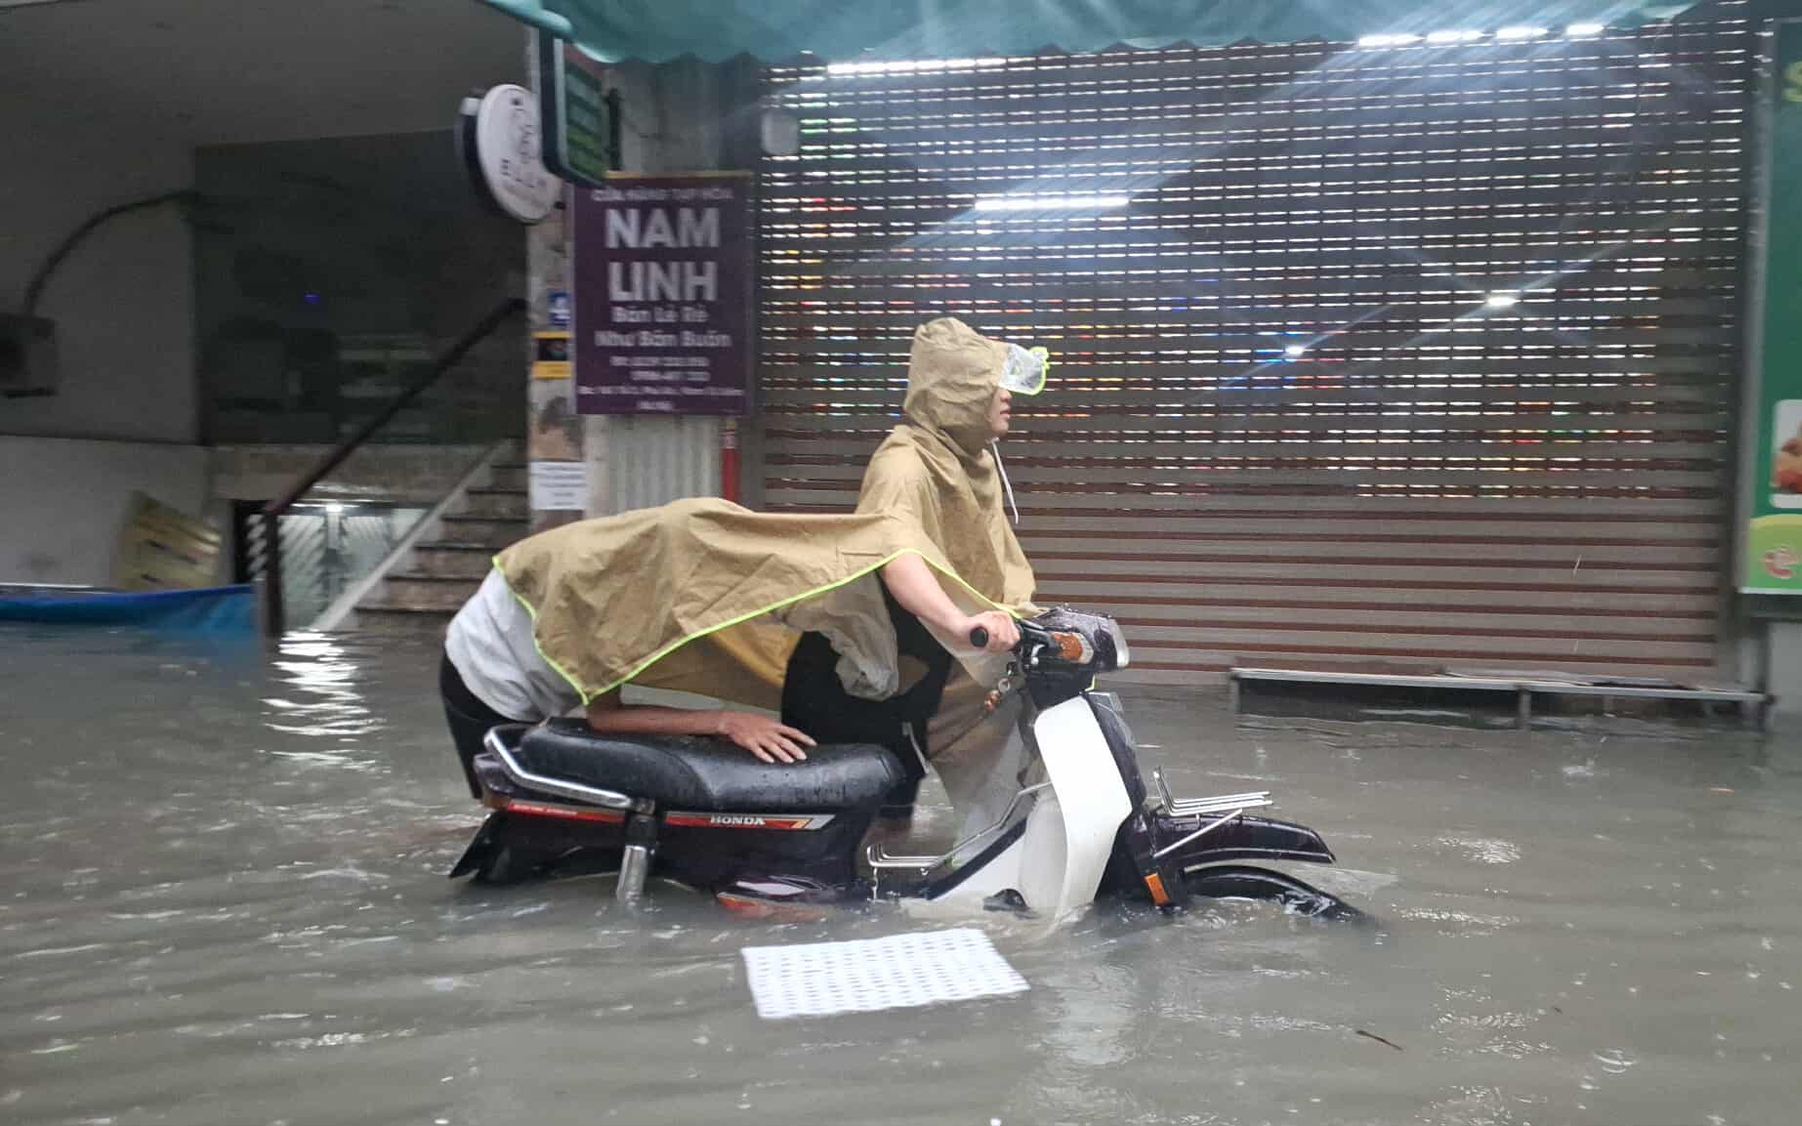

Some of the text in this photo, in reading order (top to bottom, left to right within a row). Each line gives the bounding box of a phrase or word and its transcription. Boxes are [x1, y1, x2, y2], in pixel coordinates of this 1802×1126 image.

[605, 207, 720, 249] NAM
[608, 261, 718, 302] LINH
[710, 814, 766, 825] HONDA
